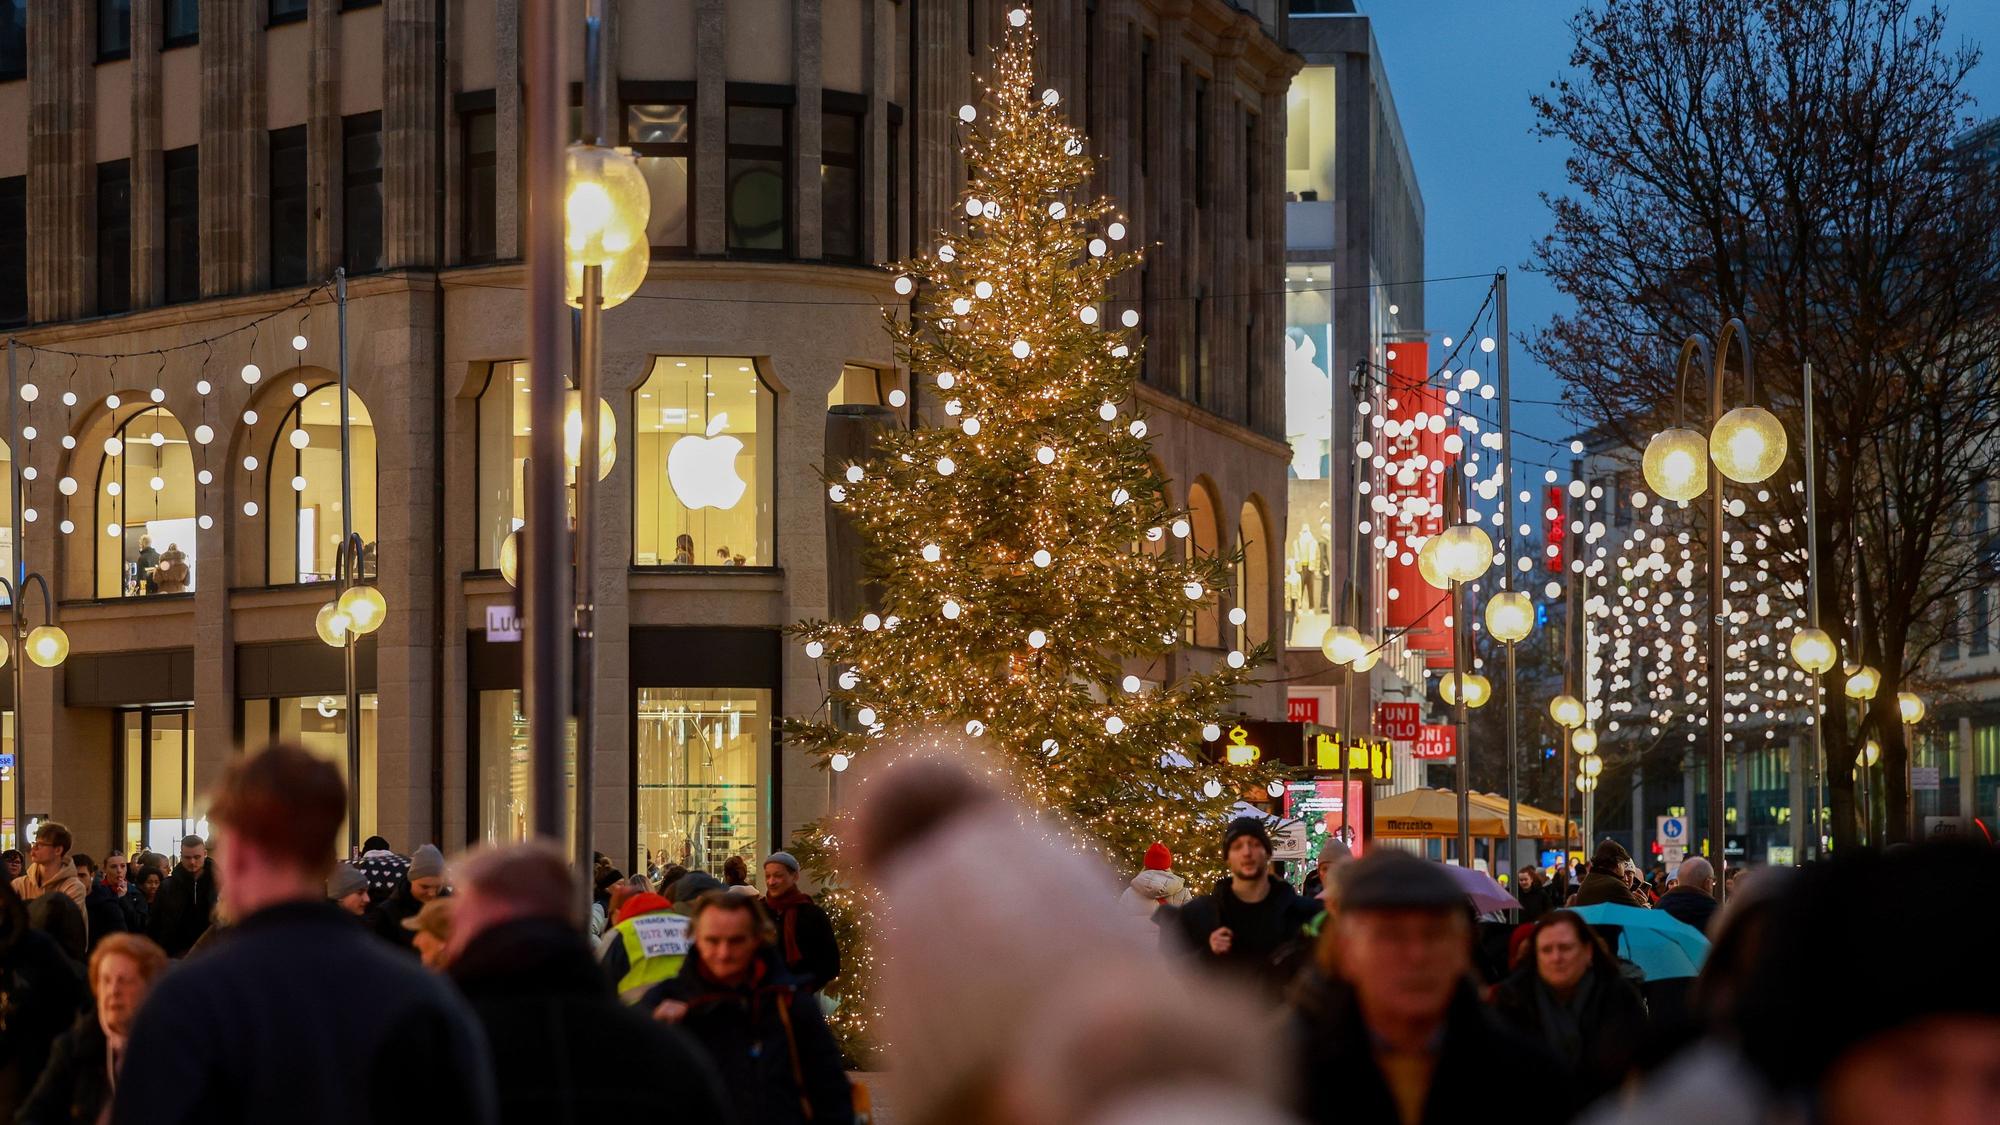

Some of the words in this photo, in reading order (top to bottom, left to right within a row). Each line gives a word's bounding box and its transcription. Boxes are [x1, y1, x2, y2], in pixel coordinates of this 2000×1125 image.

[1396, 434, 1421, 537] UIO
[1385, 707, 1413, 721] UNI
[1386, 723, 1416, 737] QLO
[1416, 743, 1444, 757] QLO
